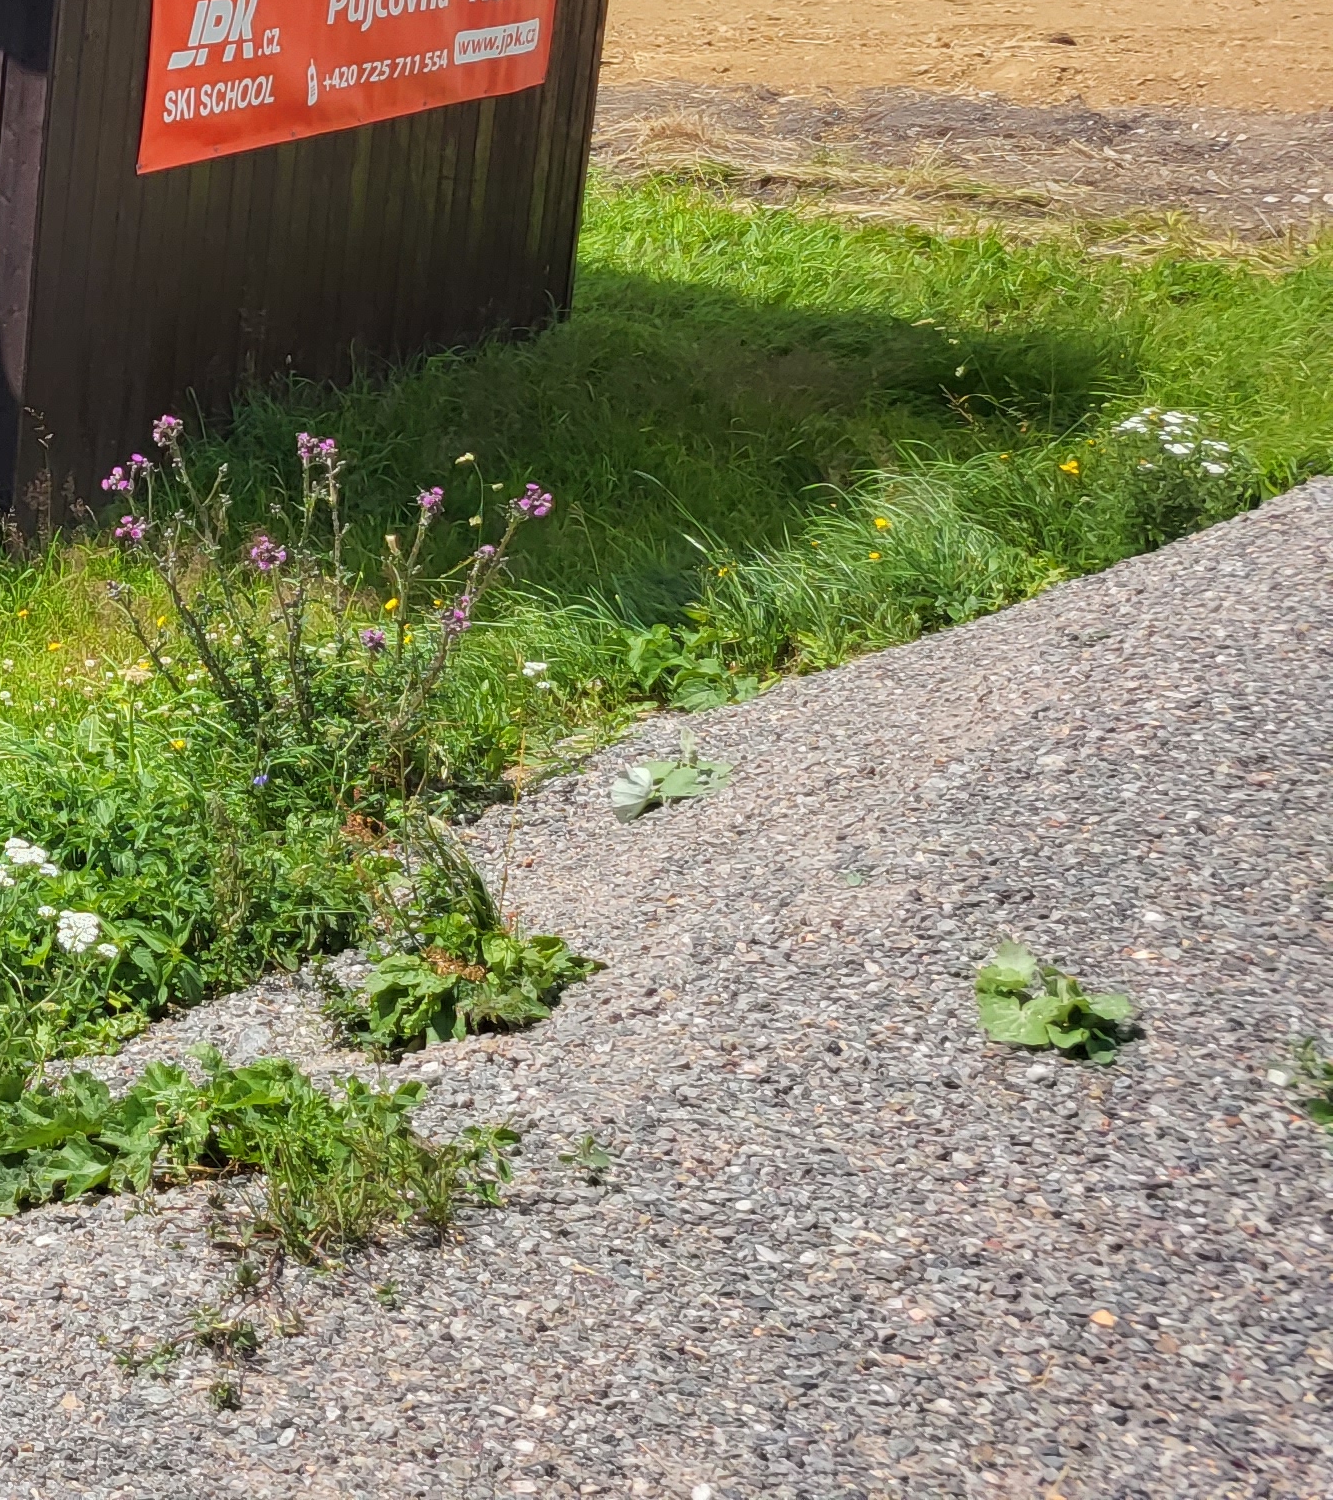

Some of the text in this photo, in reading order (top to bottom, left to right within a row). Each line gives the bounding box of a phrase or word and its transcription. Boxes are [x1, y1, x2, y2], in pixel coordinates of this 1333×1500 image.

[458, 26, 537, 57] www.jpk.cz
[322, 48, 449, 92] +420 725 711 554
[163, 74, 275, 124] SKI SCHOOL
